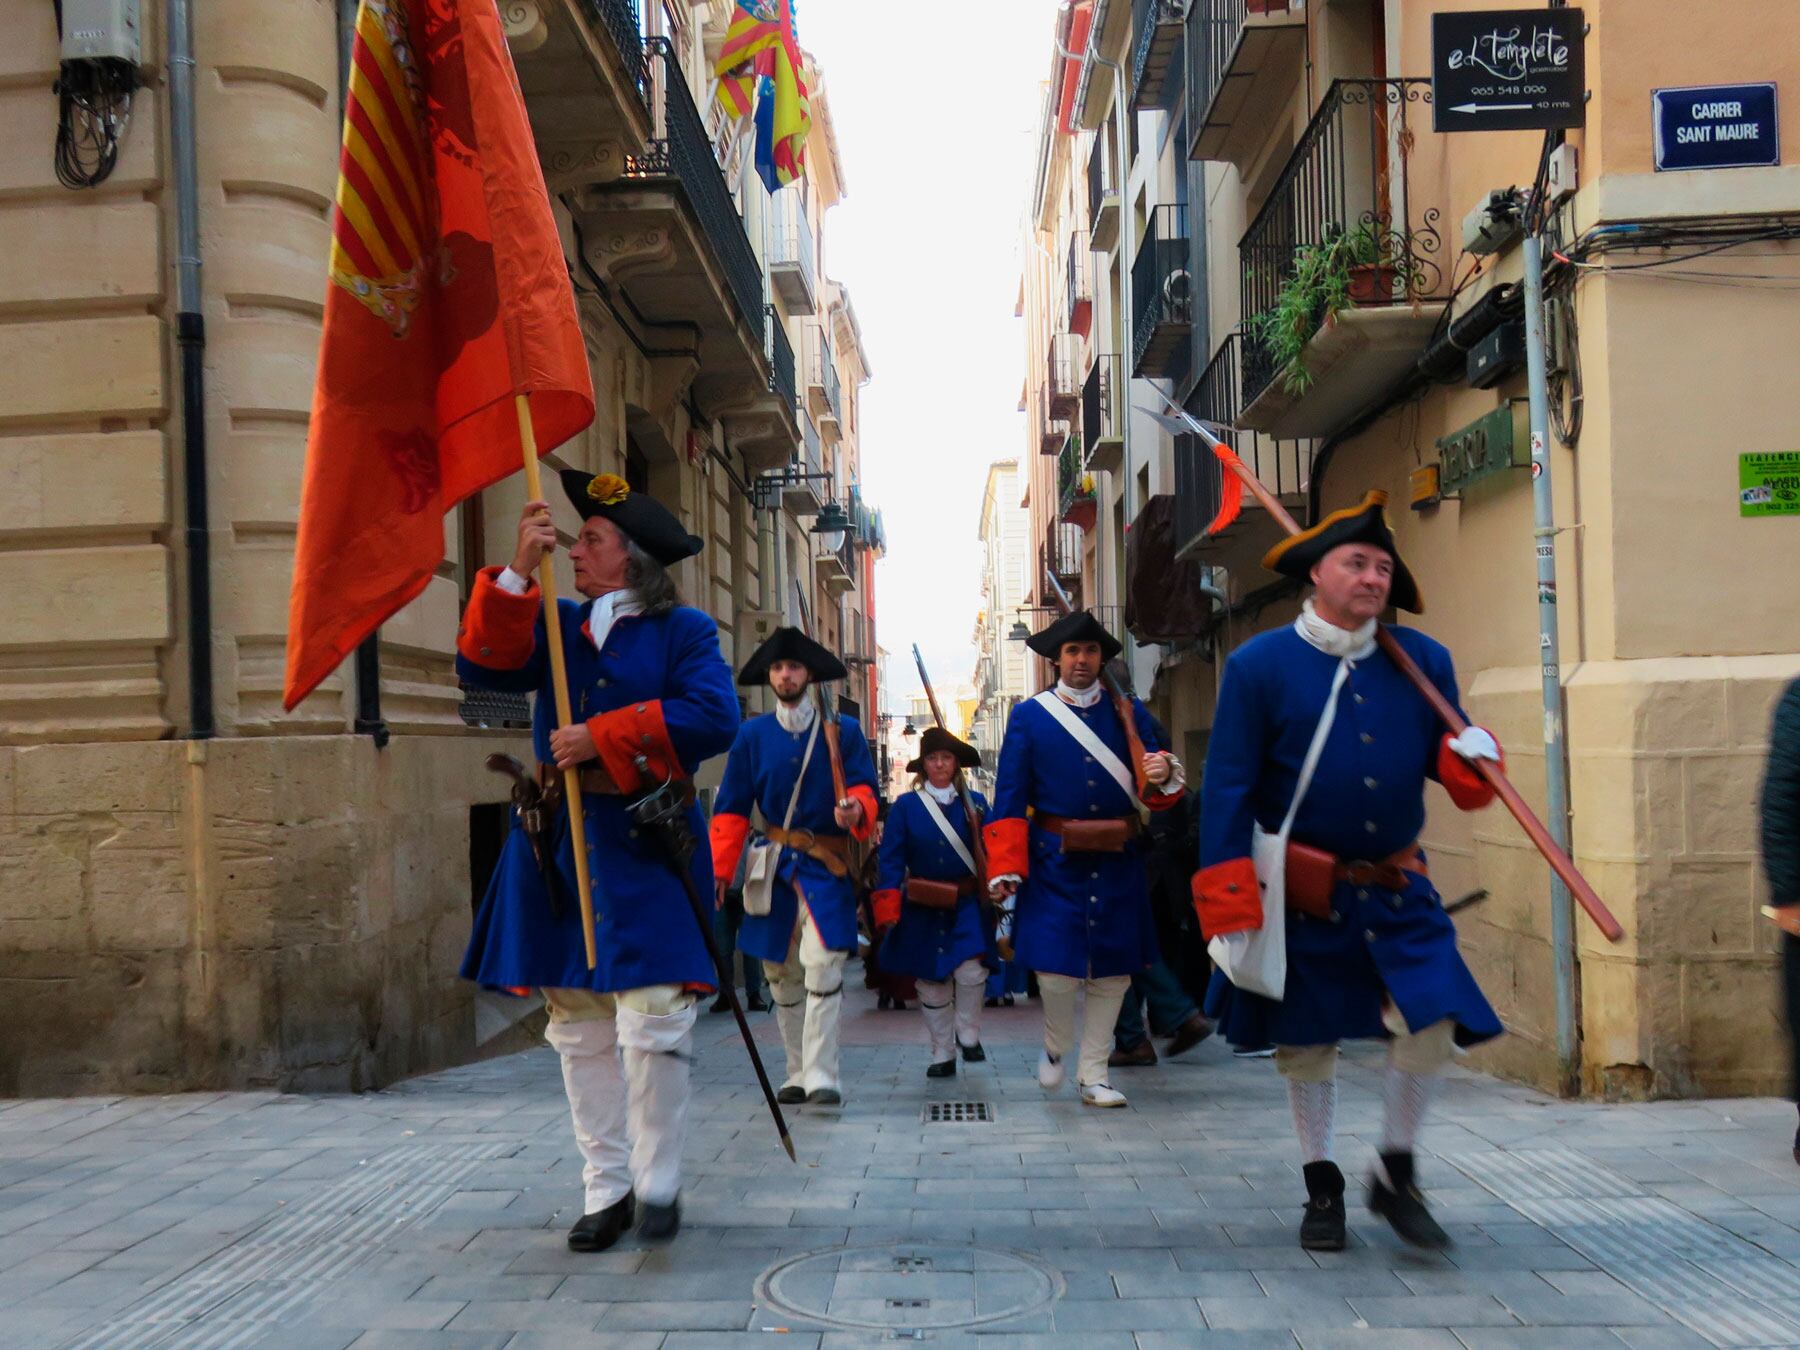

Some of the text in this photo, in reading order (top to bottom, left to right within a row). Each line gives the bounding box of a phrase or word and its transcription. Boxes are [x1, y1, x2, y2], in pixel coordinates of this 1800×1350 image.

[1498, 86, 1520, 95] 548
[1691, 101, 1742, 120] CARRER
[1676, 123, 1759, 144] SANT MAURE
